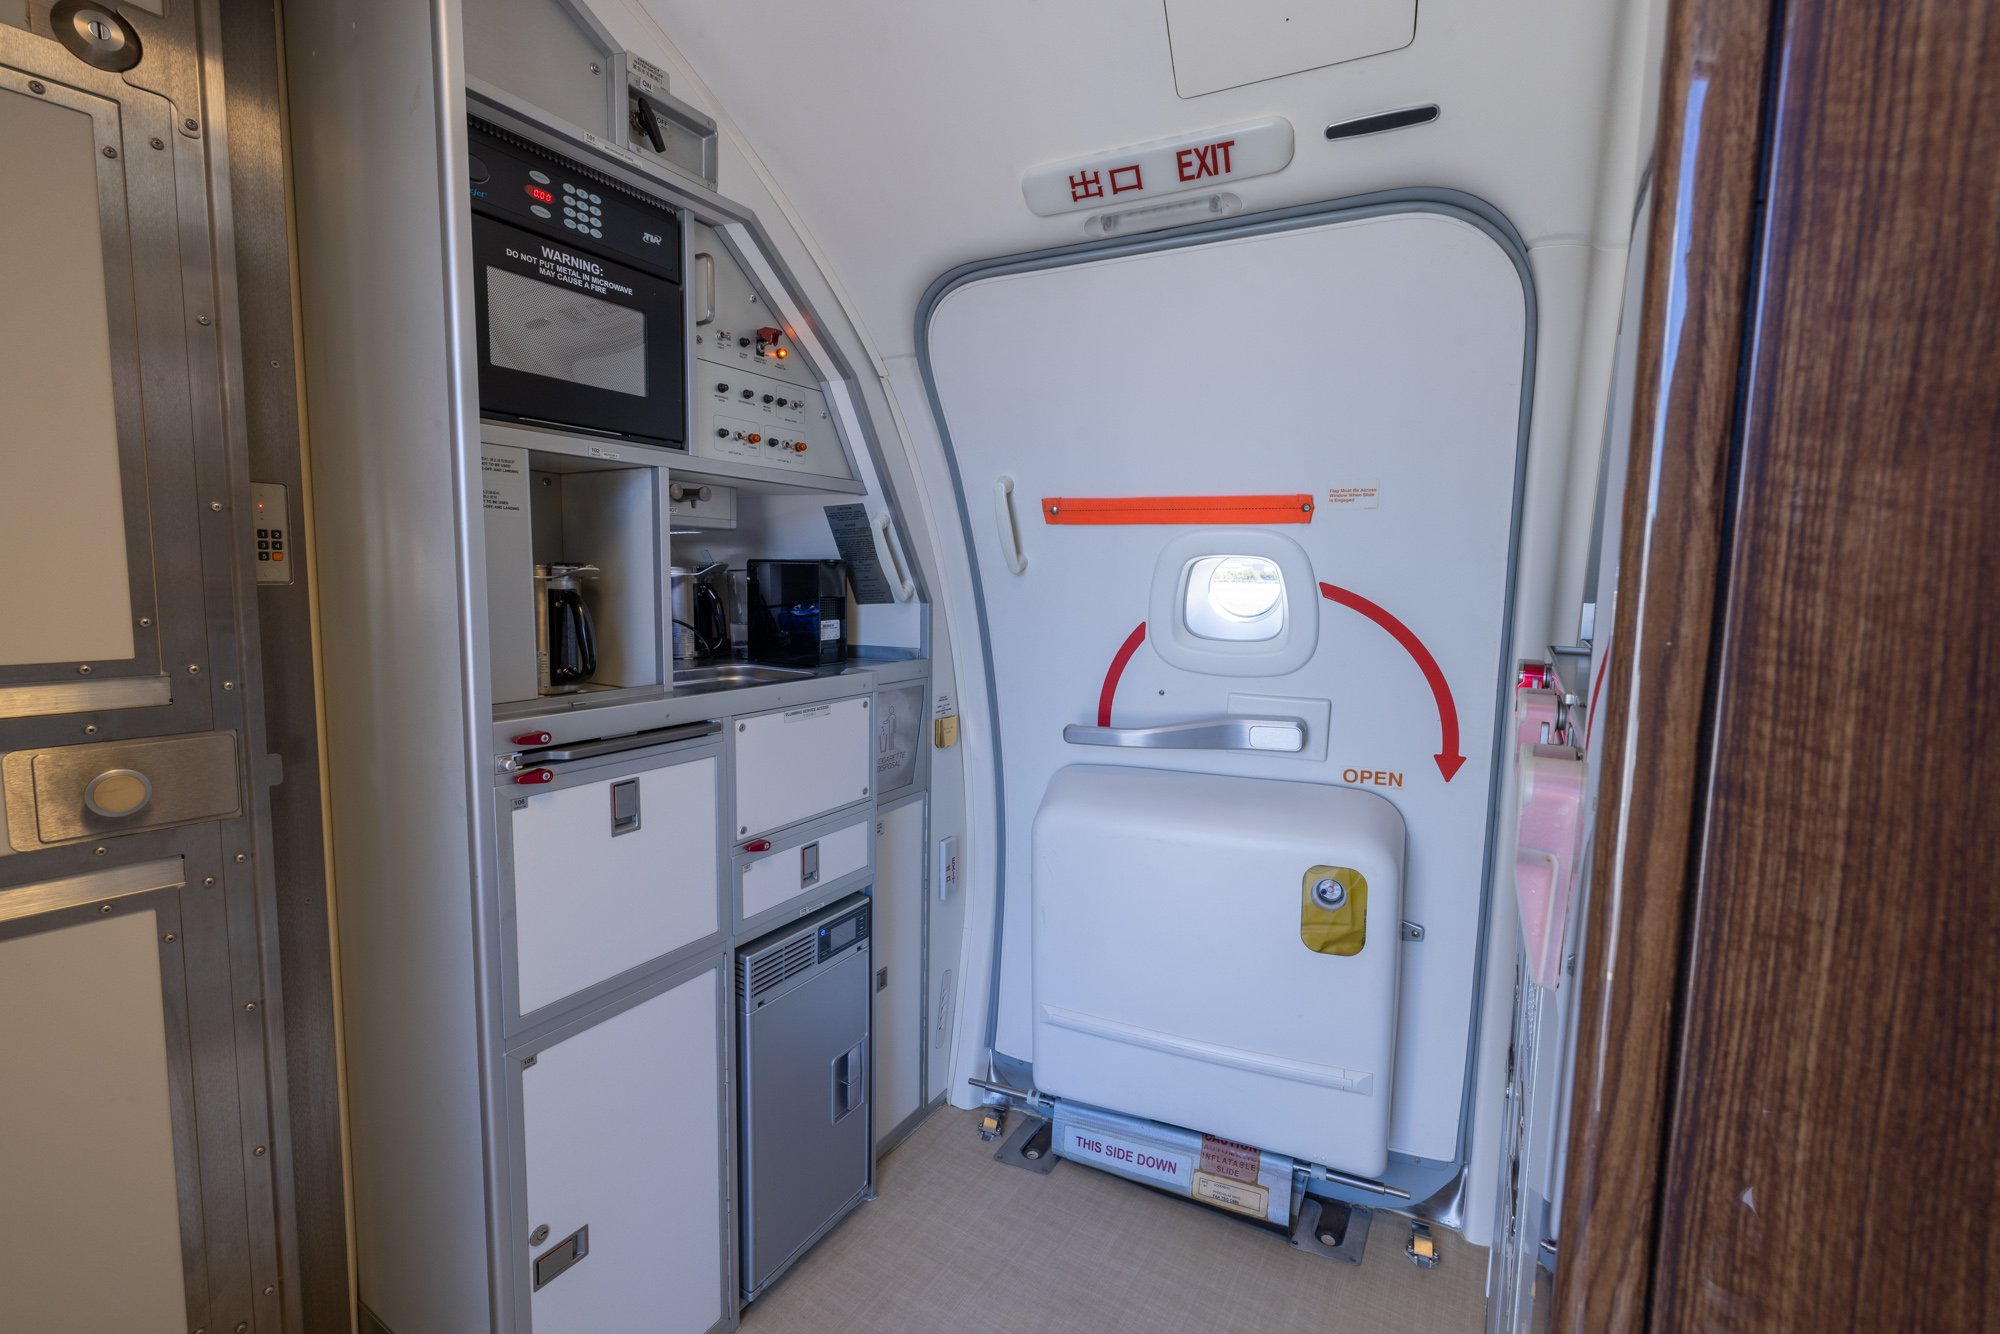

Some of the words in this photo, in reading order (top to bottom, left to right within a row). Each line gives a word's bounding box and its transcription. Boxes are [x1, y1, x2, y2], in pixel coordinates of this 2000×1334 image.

[642, 80, 652, 90] ON
[1176, 140, 1235, 182] EXIT
[1069, 165, 1144, 202] 出口
[506, 248, 519, 259] DO
[520, 253, 537, 265] NOT
[539, 259, 555, 270] PUT
[556, 264, 581, 279] METAL
[582, 274, 590, 282] IN
[591, 276, 633, 296] MICROWAVE
[541, 246, 604, 276] WARNING:
[539, 267, 556, 277] MAY
[557, 272, 583, 287] CAUSE
[584, 281, 590, 289] A
[591, 284, 607, 295] FIRE
[1343, 768, 1403, 787] OPEN
[1076, 1136, 1102, 1153] THIS
[1105, 1145, 1134, 1163] SIDE
[1137, 1153, 1177, 1175] DOWN
[1202, 1152, 1256, 1172] INFLATABLE
[1216, 1165, 1240, 1177] SLIDE
